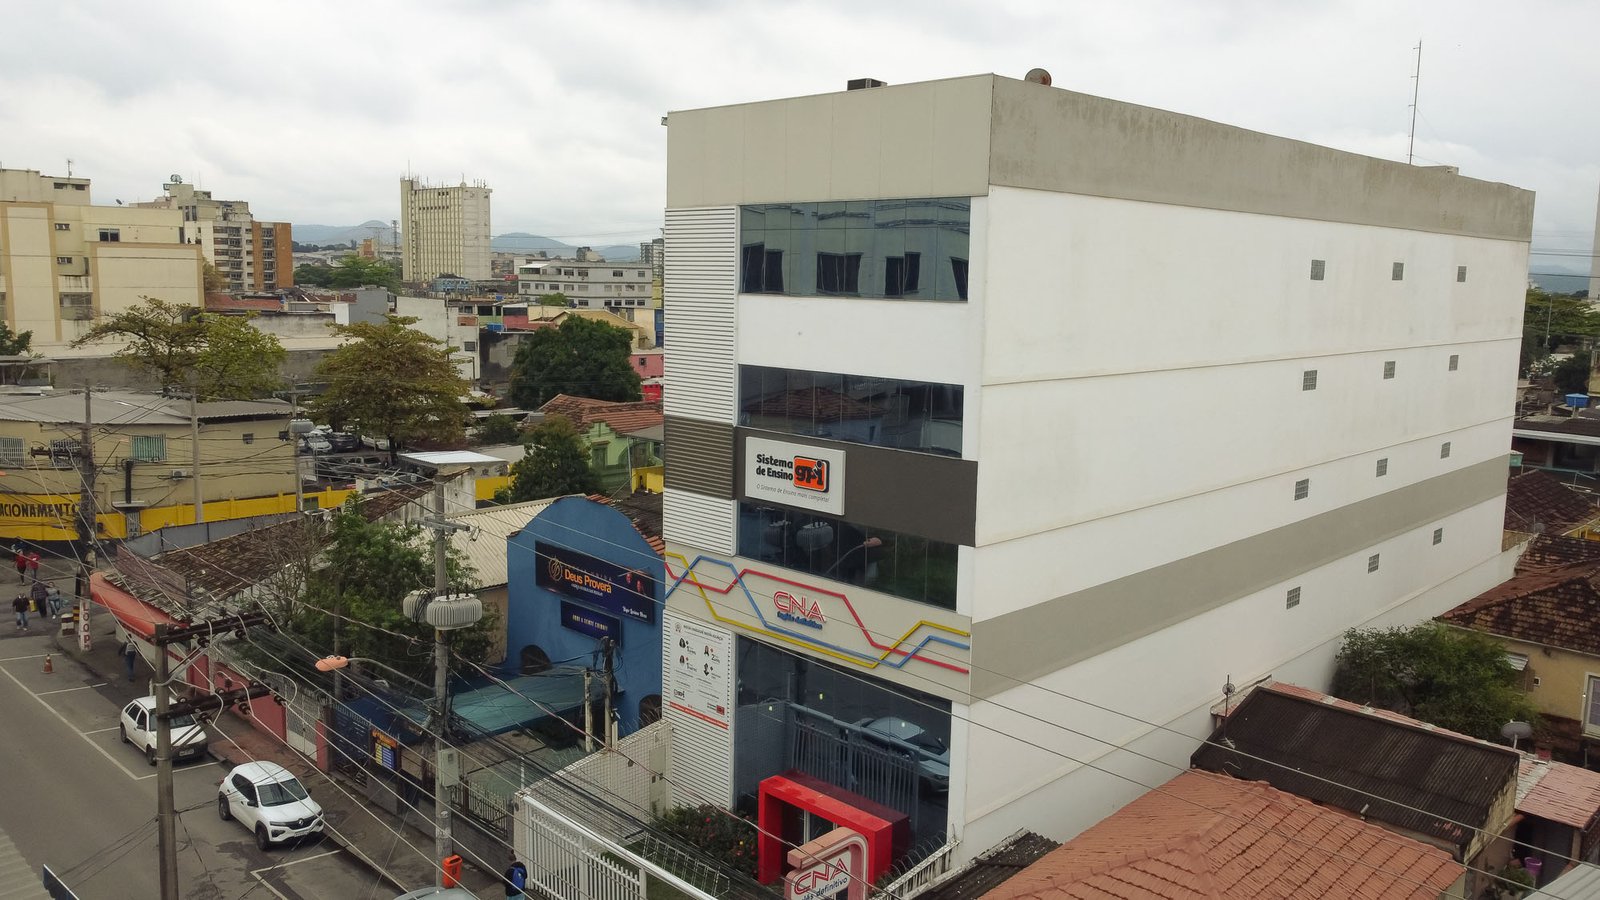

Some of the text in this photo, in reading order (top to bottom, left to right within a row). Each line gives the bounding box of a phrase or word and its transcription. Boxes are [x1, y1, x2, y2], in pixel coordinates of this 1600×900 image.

[756, 453, 794, 469] Sistema
[755, 465, 794, 481] de Ensino
[564, 568, 583, 584] Deus
[773, 591, 826, 623] CNA
[794, 858, 849, 895] CNA
